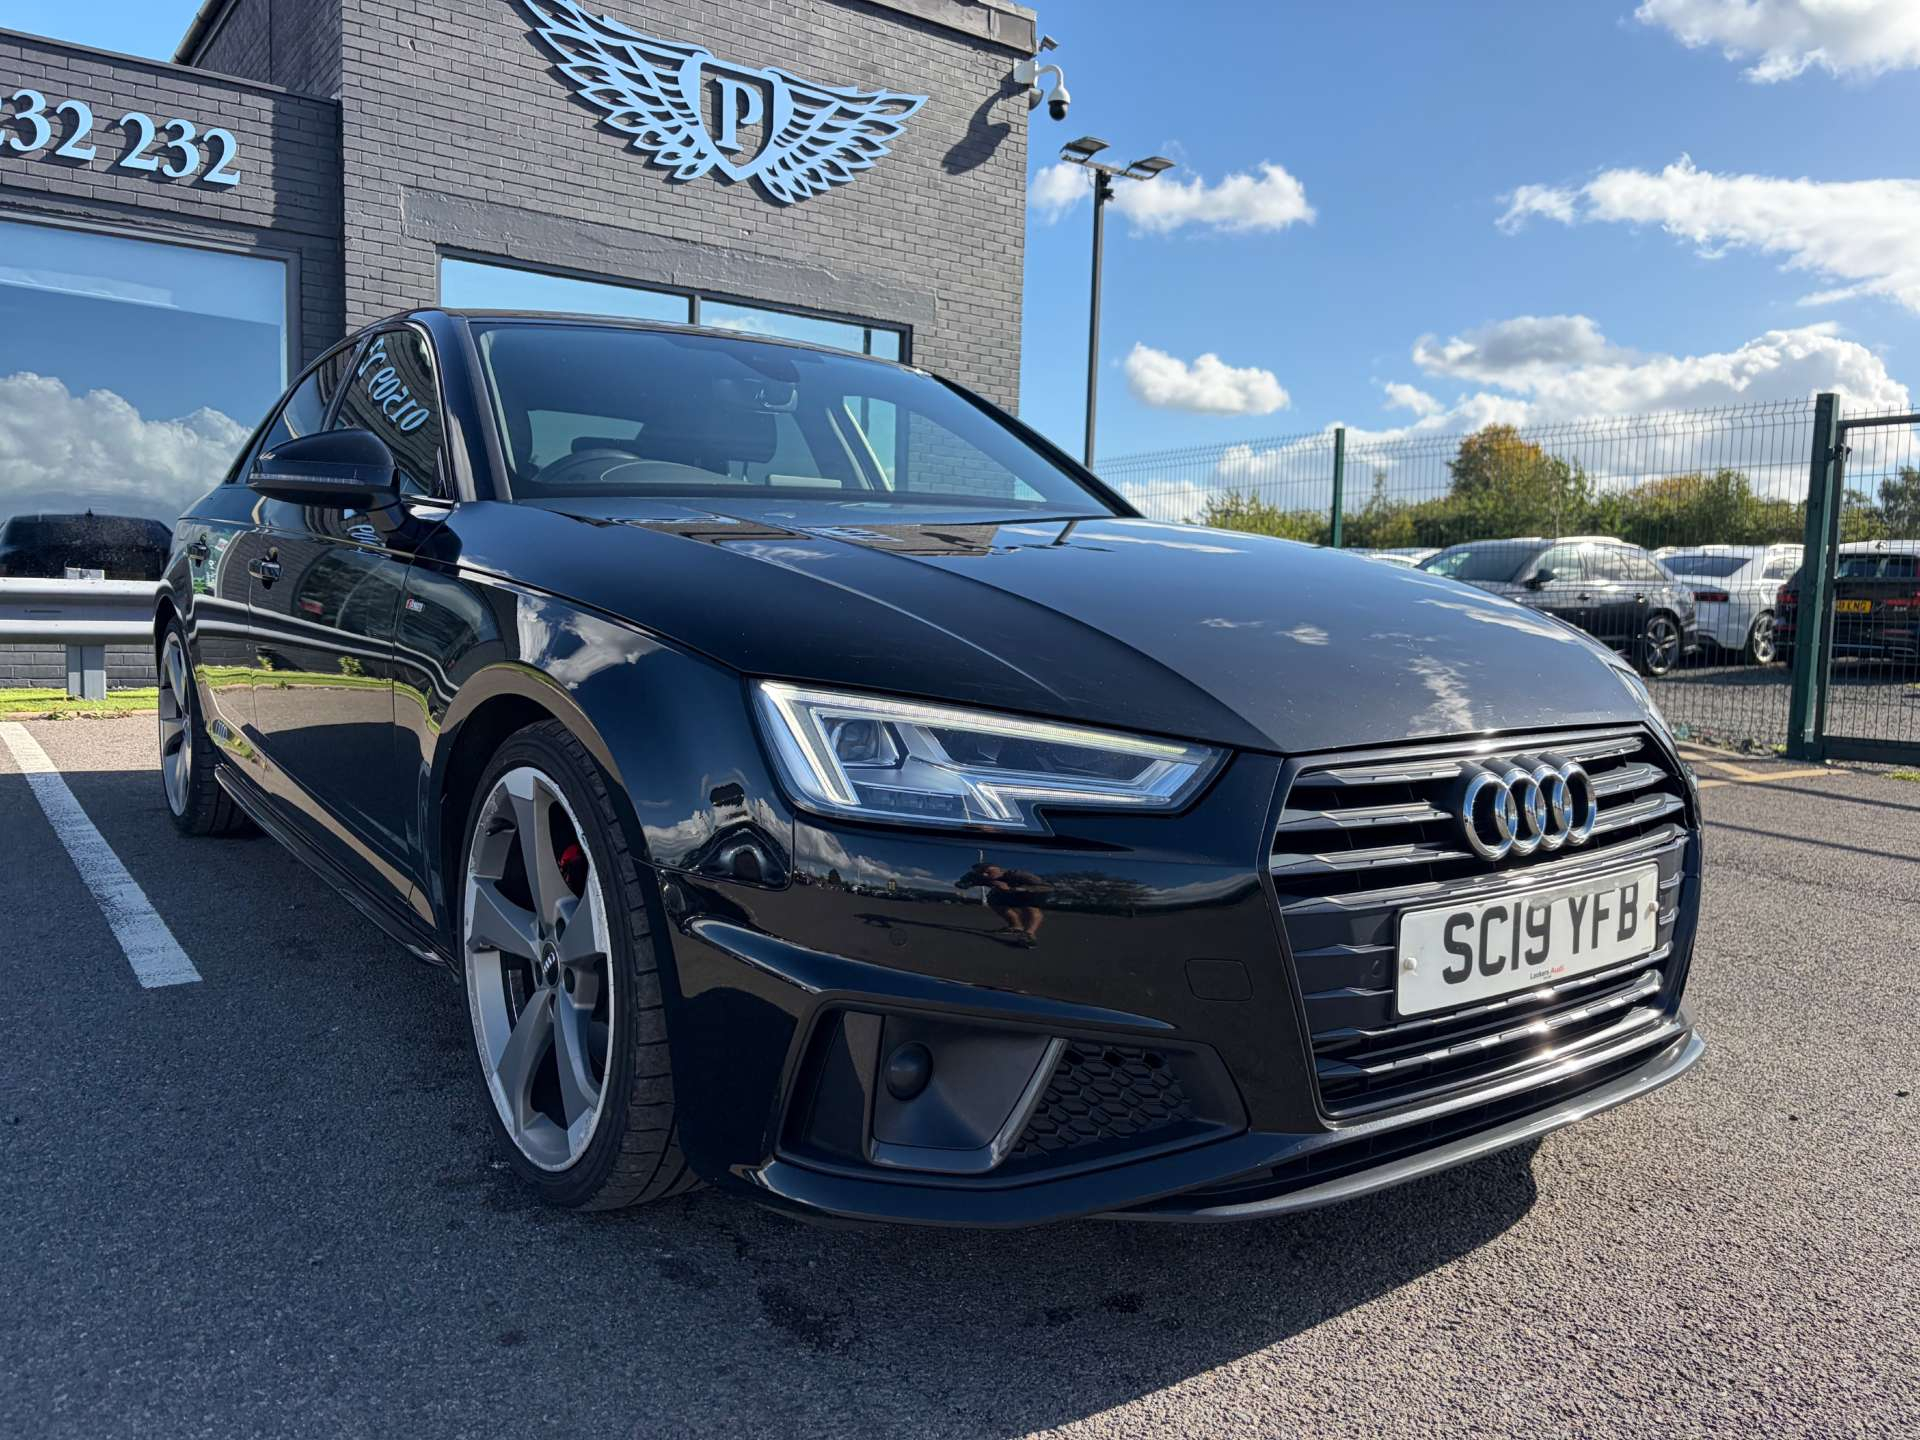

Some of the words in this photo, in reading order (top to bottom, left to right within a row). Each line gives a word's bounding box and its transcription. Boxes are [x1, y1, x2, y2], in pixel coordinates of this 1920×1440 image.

[0, 88, 97, 161] 32
[120, 111, 241, 186] 232
[715, 77, 764, 152] P
[1443, 901, 1552, 985] SC19
[1568, 880, 1639, 955] YFB
